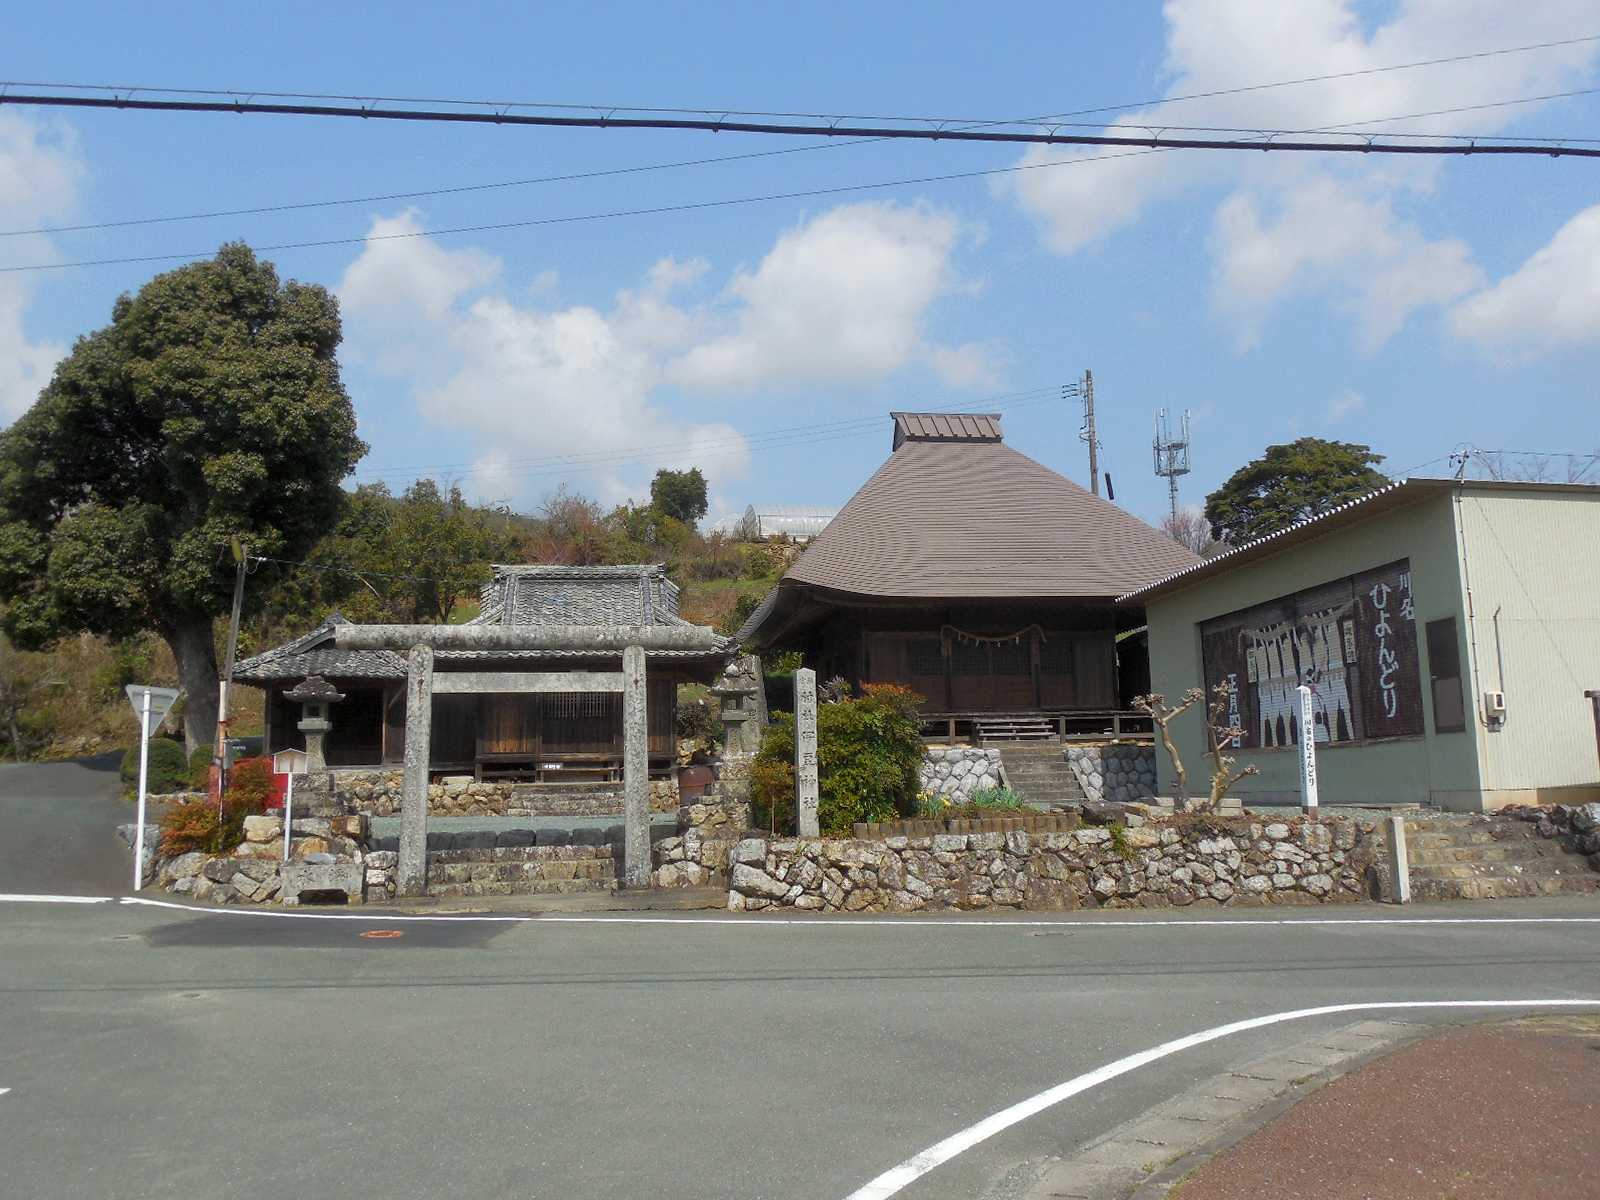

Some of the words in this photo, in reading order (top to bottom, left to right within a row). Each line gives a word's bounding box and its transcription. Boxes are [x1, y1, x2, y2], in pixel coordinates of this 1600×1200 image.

[1399, 571, 1416, 620] 川名
[1369, 583, 1399, 718] ひよんどり
